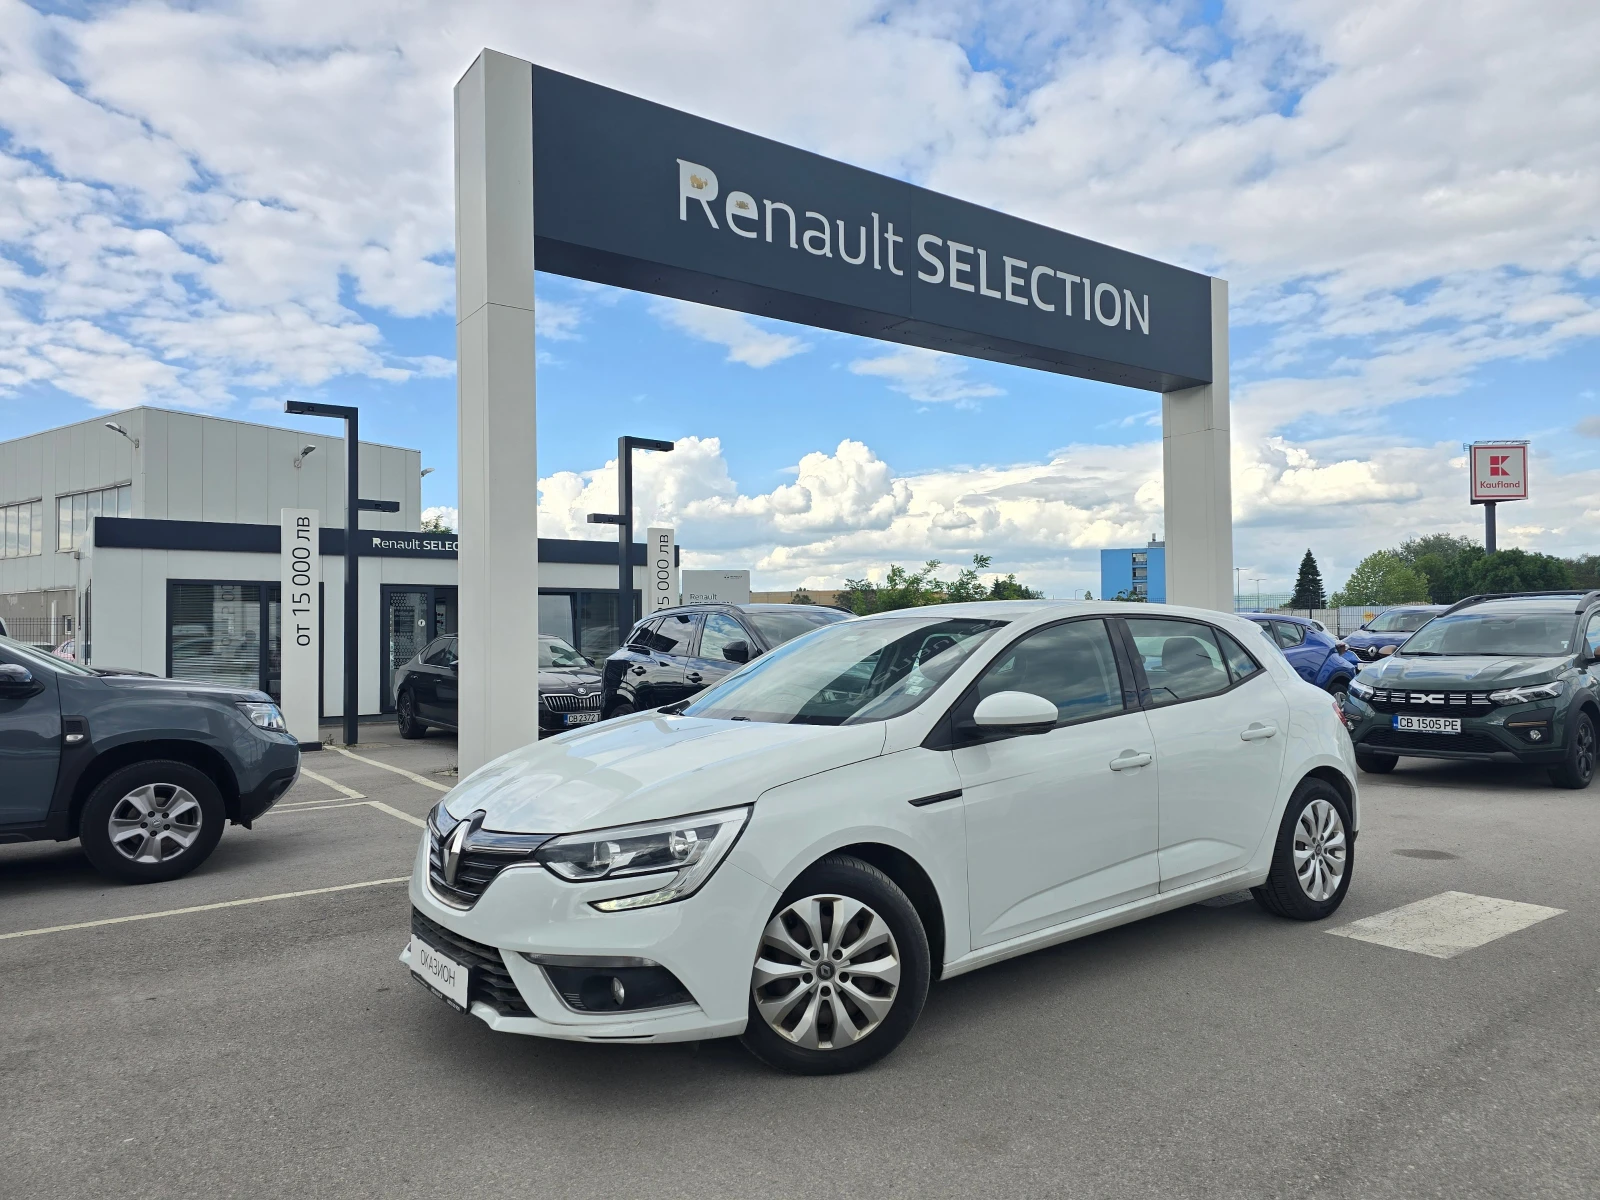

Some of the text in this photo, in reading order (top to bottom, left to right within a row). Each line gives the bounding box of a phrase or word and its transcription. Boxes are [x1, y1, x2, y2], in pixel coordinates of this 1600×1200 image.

[676, 158, 1149, 335] Renault SELECTION
[1480, 480, 1520, 489] Kaufland
[372, 537, 420, 549] Renault
[291, 547, 311, 586] 000
[656, 559, 670, 591] 000
[292, 592, 311, 616] 15
[657, 596, 670, 611] 5
[689, 593, 718, 601] Renault
[1399, 717, 1459, 731] CB 1505 PE
[420, 949, 456, 988] ОКАЗИОН
